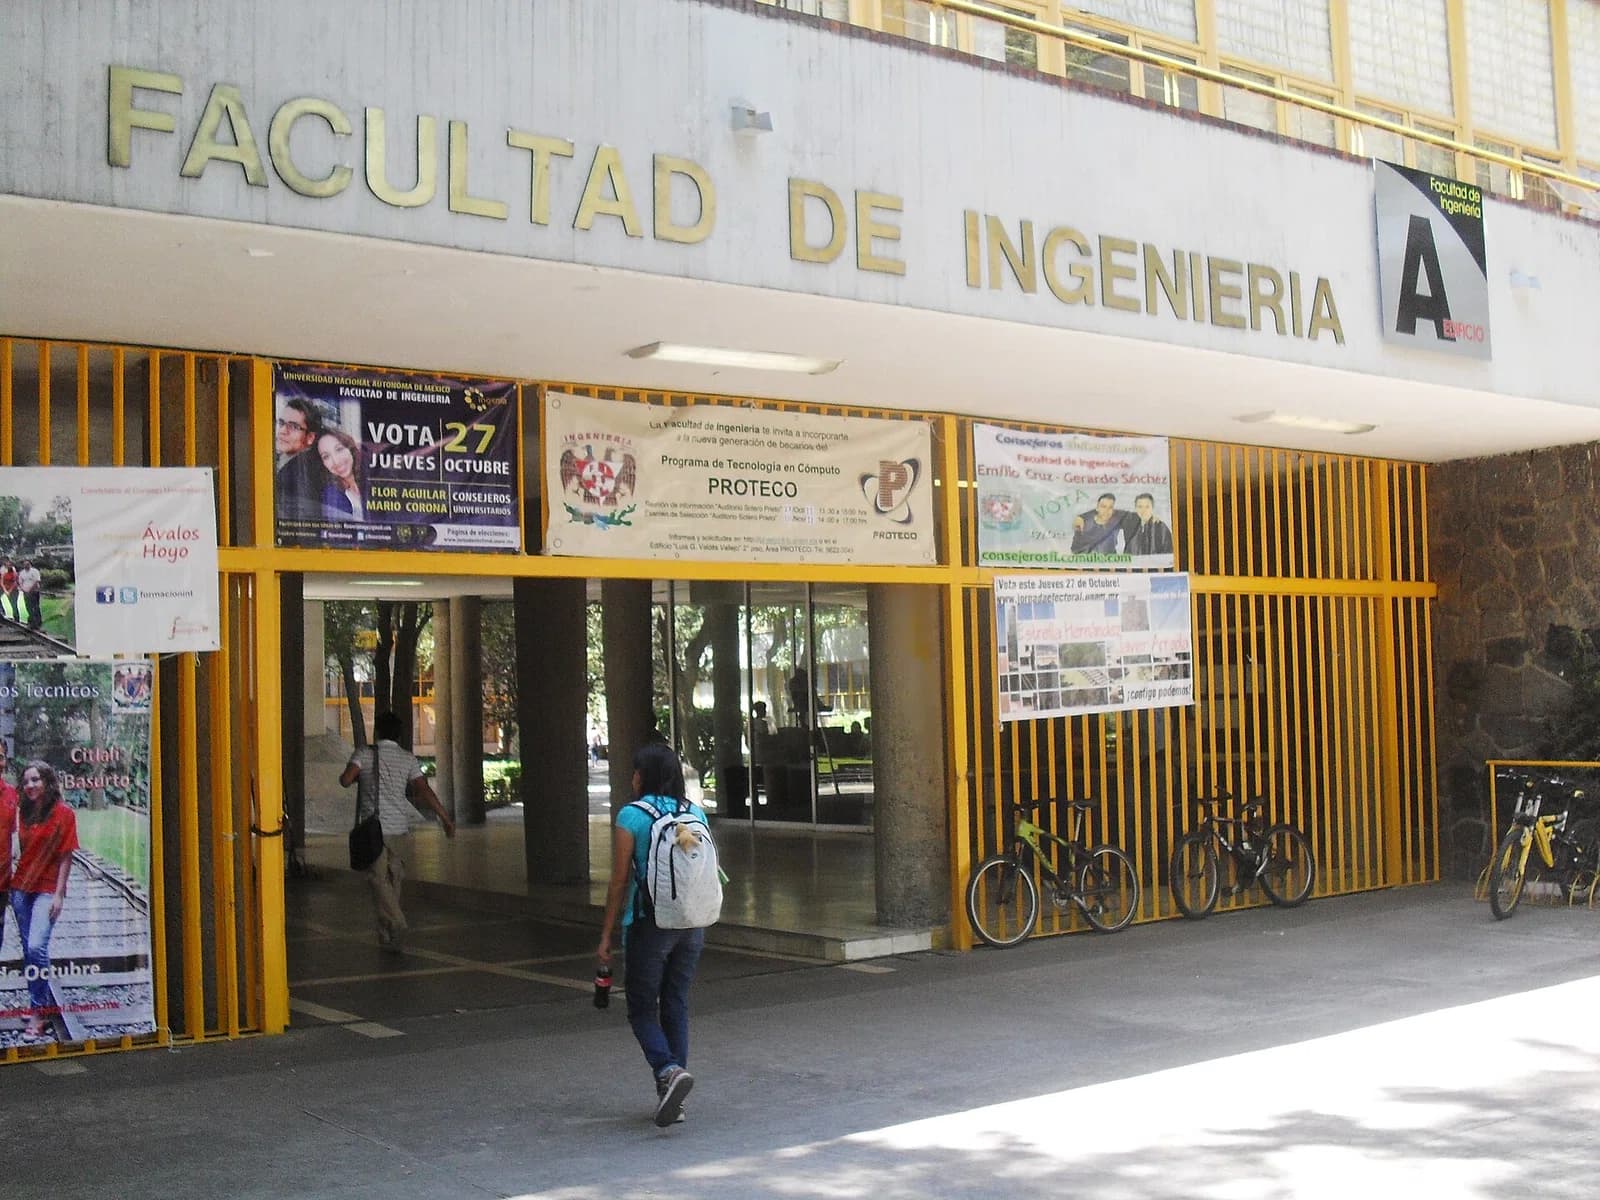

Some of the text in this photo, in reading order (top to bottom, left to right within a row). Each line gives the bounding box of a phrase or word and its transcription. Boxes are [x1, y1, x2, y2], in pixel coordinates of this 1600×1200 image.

[1430, 176, 1481, 203] Facultad de
[107, 64, 1346, 346] FACULTAD DE INGENIERIA
[1396, 213, 1457, 342] A
[1443, 319, 1485, 343] EDIFICIO
[283, 371, 451, 394] UNIVERSIDAD NACIONAL AUTONOMA DE MEXICO
[339, 386, 451, 405] FACULTAD DE INGENIERIA
[367, 421, 497, 455] VOTA 27
[704, 422, 715, 431] de
[762, 426, 770, 435] te
[772, 426, 794, 437] invita
[802, 430, 849, 441] incorporarte
[766, 439, 777, 449] de
[779, 440, 814, 450] becarios
[995, 433, 1064, 450] Consejeros
[369, 452, 511, 476] JUEVES OCTUBRE
[661, 455, 709, 469] Programa
[712, 459, 724, 469] de
[784, 463, 795, 473] en
[1016, 453, 1062, 466] Facultad
[1063, 457, 1077, 467] de
[977, 463, 1020, 479] Emilio
[1025, 468, 1054, 482] Cruz
[1063, 471, 1119, 485] Gerardo
[371, 486, 447, 501] FLOR AGUILAR
[708, 477, 798, 498] PROTECO
[452, 491, 512, 504] CONSEJEROS
[1033, 488, 1090, 520] VOTA
[366, 501, 448, 514] MARIO CORONA
[452, 505, 512, 516] UNIVERSITARIOS
[142, 519, 200, 541] Ávalos
[872, 530, 918, 541] PROTECO
[143, 543, 189, 564] Hoyo
[998, 578, 1017, 590] Vota
[1019, 579, 1036, 590] este
[1038, 578, 1064, 590] Jueves
[1066, 578, 1075, 589] 27
[1077, 578, 1087, 589] de
[64, 773, 131, 790] Basurto
[24, 961, 101, 981] Octubre
